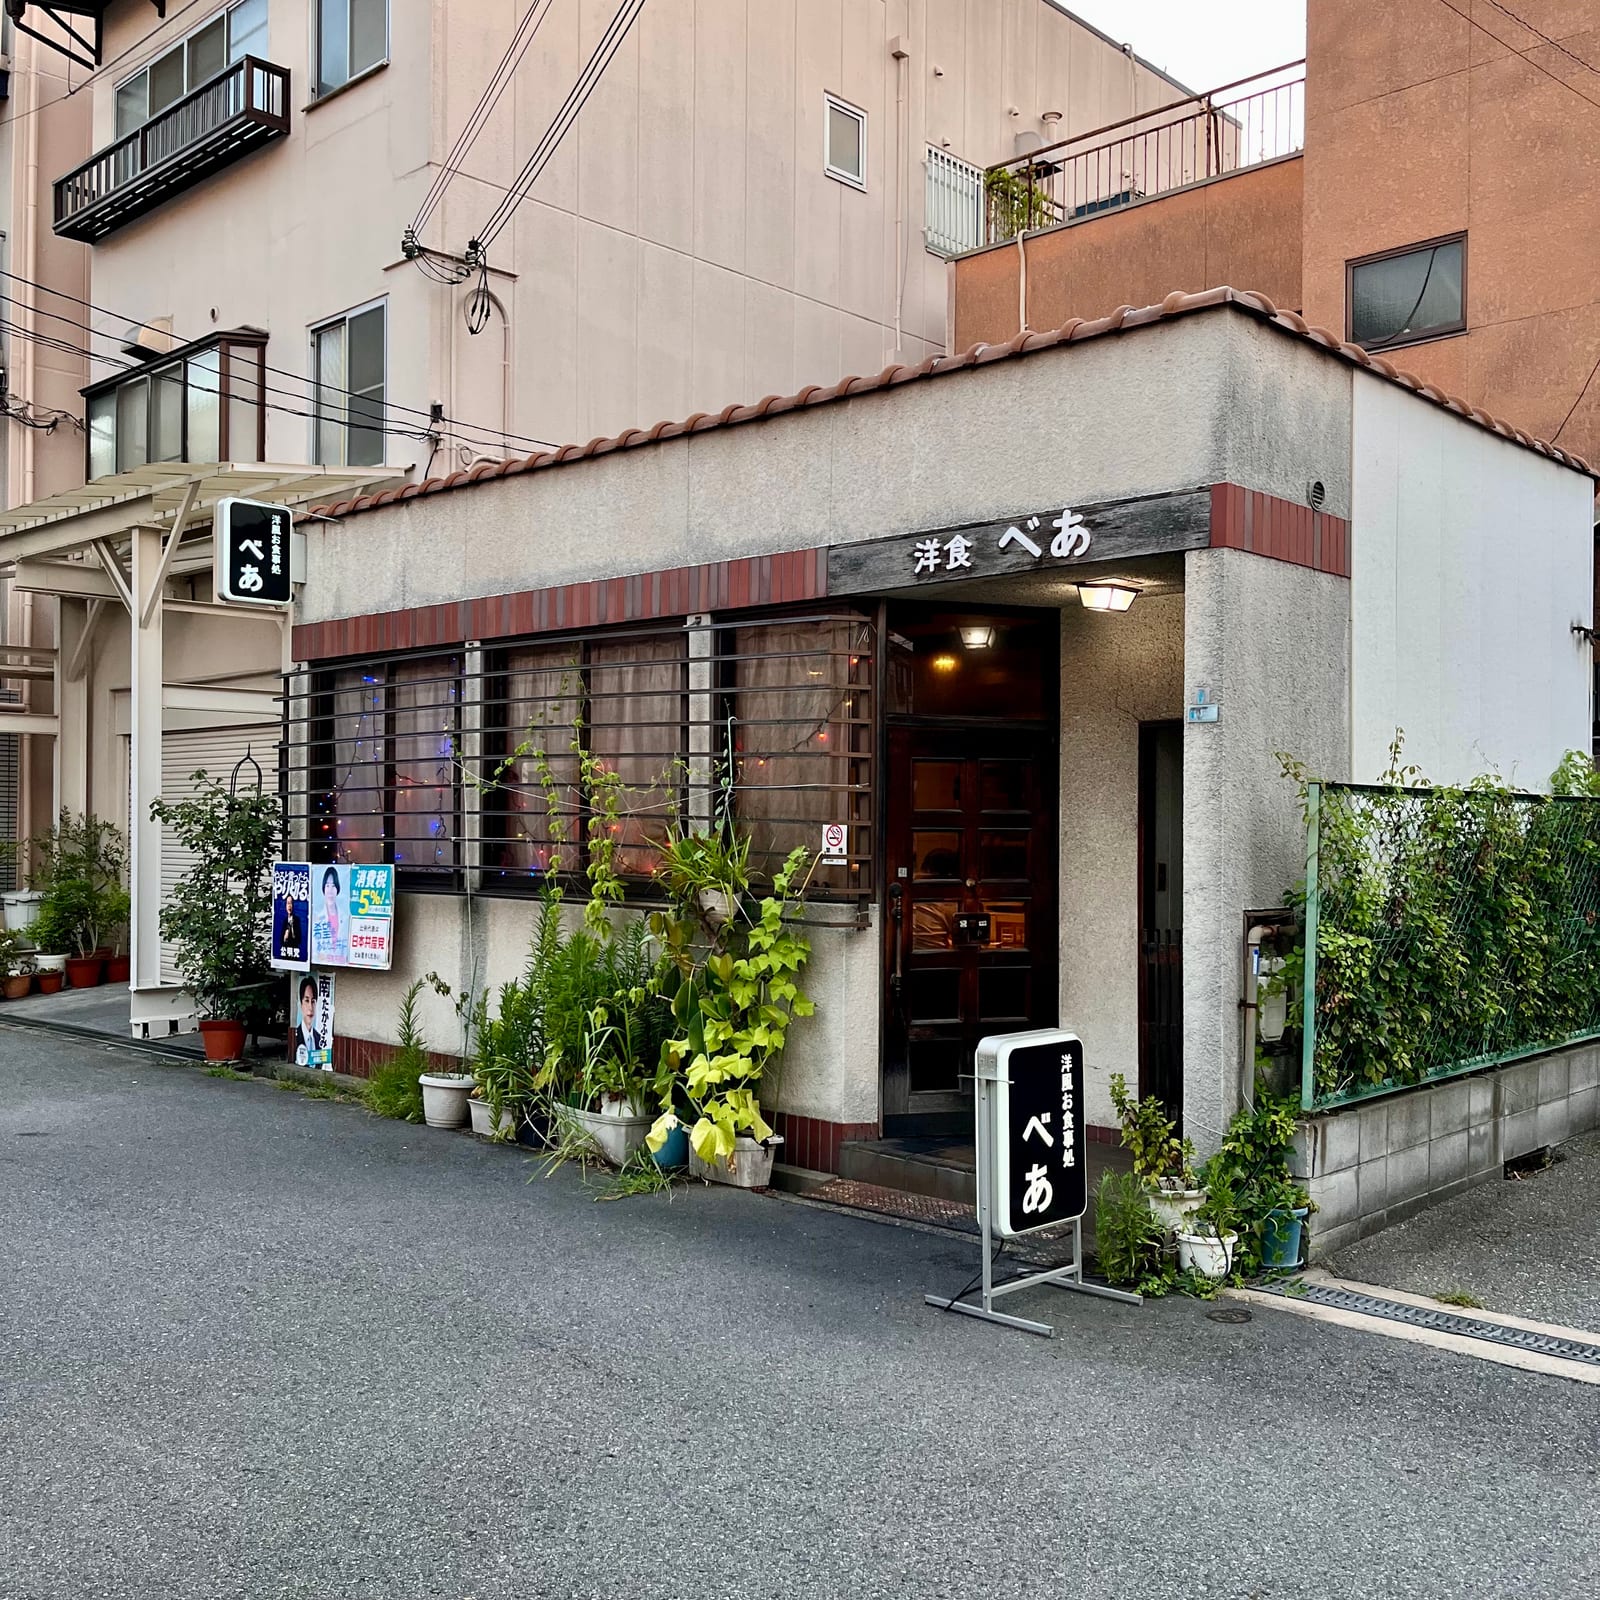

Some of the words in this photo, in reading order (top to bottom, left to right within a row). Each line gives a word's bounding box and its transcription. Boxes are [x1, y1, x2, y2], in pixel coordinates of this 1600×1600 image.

[238, 538, 265, 592] べあ
[271, 514, 282, 575] 洋風お食事処
[914, 534, 972, 574] 洋食
[998, 509, 1091, 558] べあ
[355, 869, 388, 888] 消費税
[280, 946, 301, 958] 公明党
[351, 934, 385, 950] 日本共産党
[318, 975, 332, 1049] 南たかふみ
[1061, 1053, 1075, 1168] 洋風お食事処
[1022, 1112, 1054, 1214] べあ
